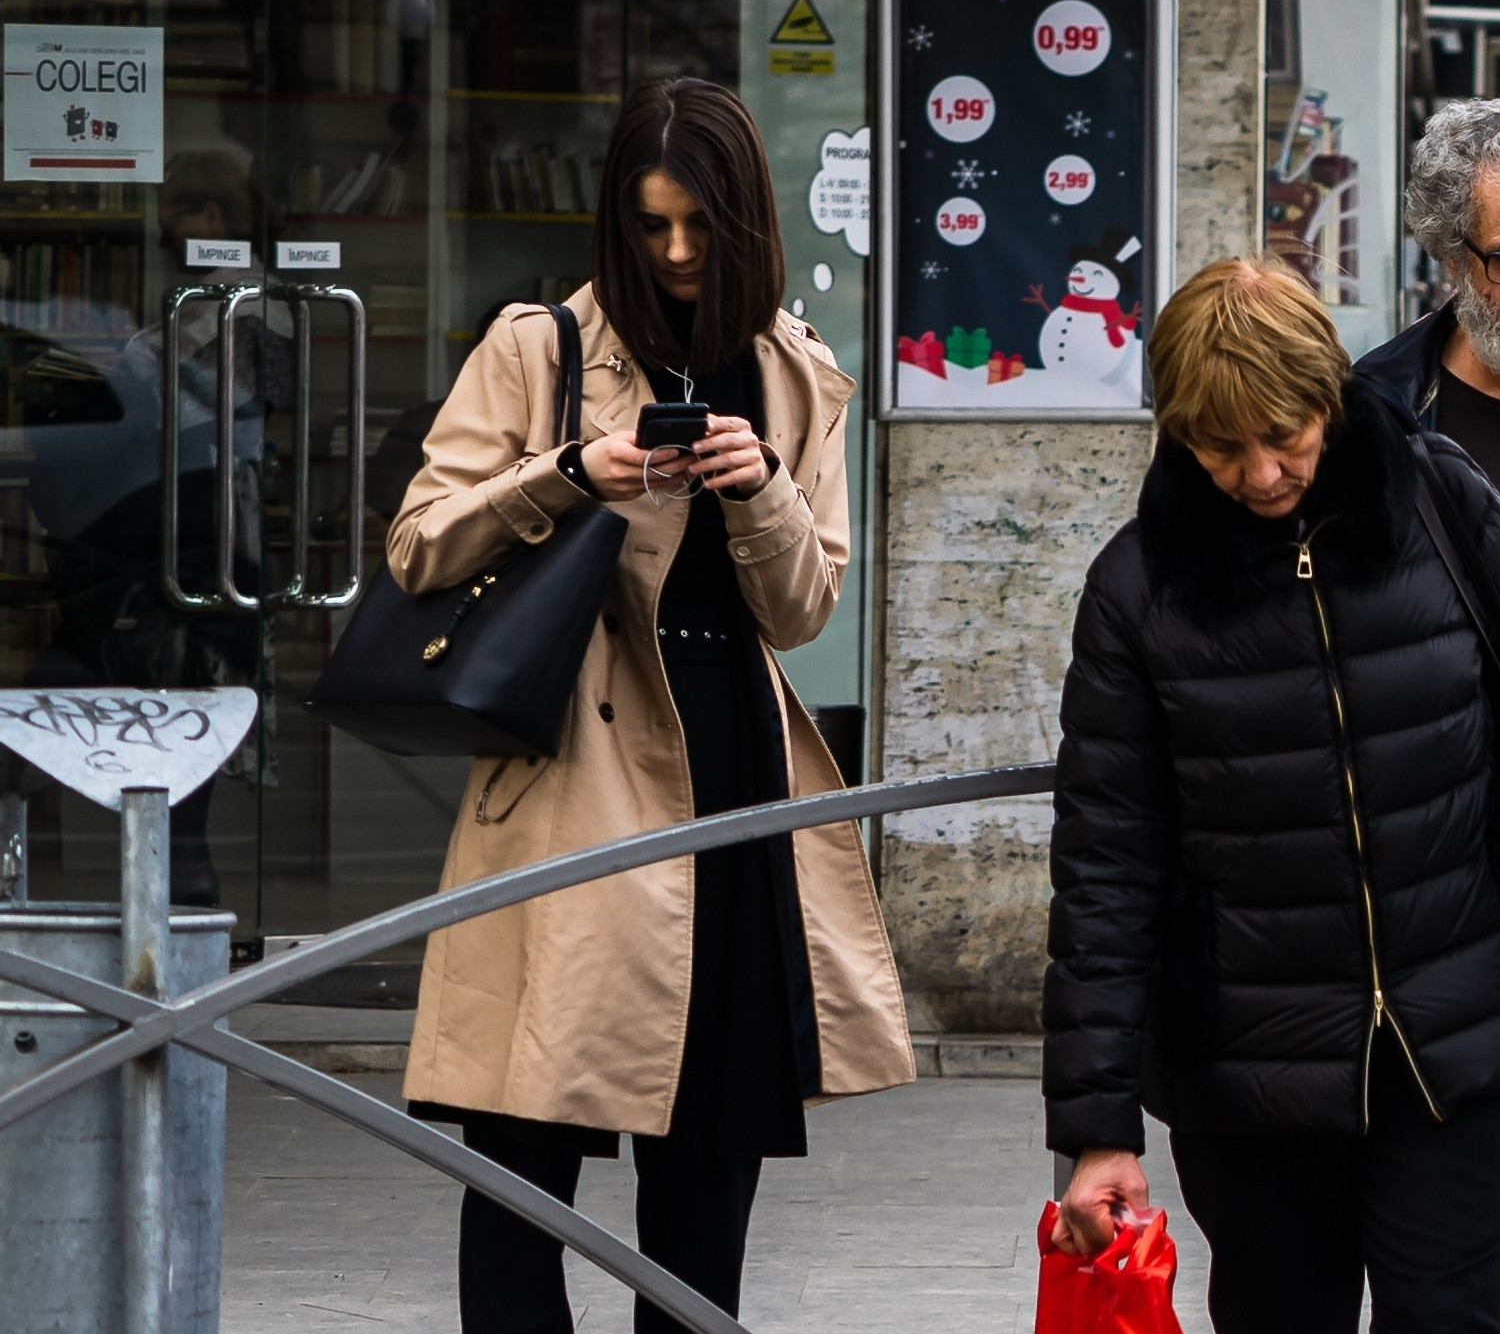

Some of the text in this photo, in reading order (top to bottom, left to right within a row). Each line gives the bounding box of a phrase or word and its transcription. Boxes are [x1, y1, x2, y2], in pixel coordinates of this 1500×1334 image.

[1037, 24, 1099, 56] 0,99
[36, 59, 147, 93] COLEGI
[931, 97, 985, 125] 1,99
[1048, 171, 1090, 192] 2,99
[939, 213, 980, 233] 3,99
